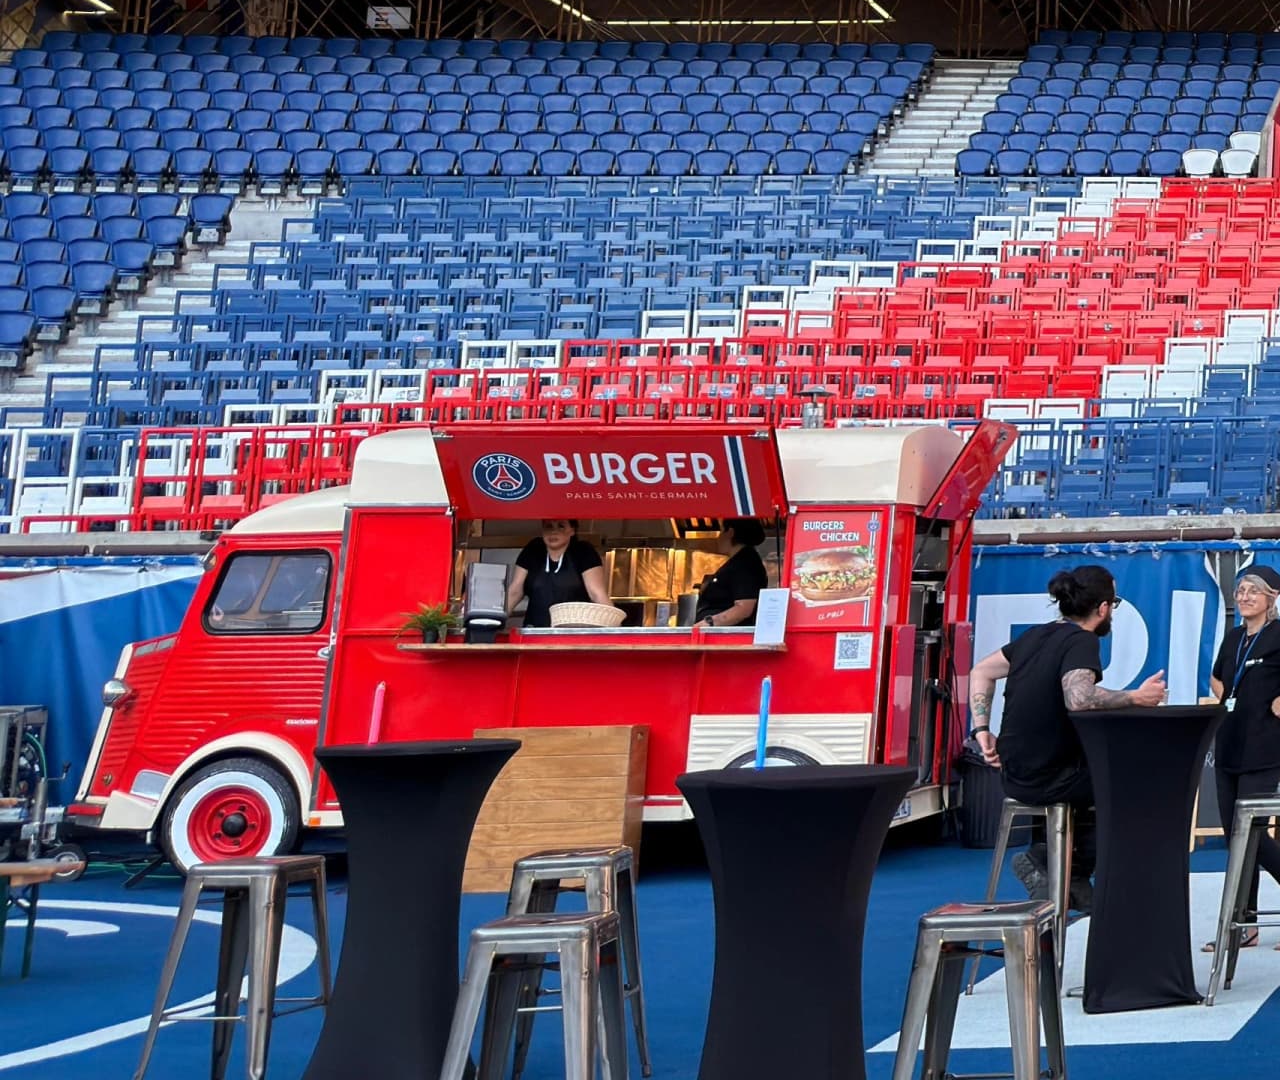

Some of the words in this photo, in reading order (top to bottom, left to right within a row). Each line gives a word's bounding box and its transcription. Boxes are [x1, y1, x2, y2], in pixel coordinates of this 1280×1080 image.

[480, 456, 521, 468] PARIS
[543, 452, 717, 484] BURGER
[607, 492, 708, 500] SAINT-GERMAIN
[803, 521, 845, 531] BURGERS
[820, 532, 860, 542] CHICKEN
